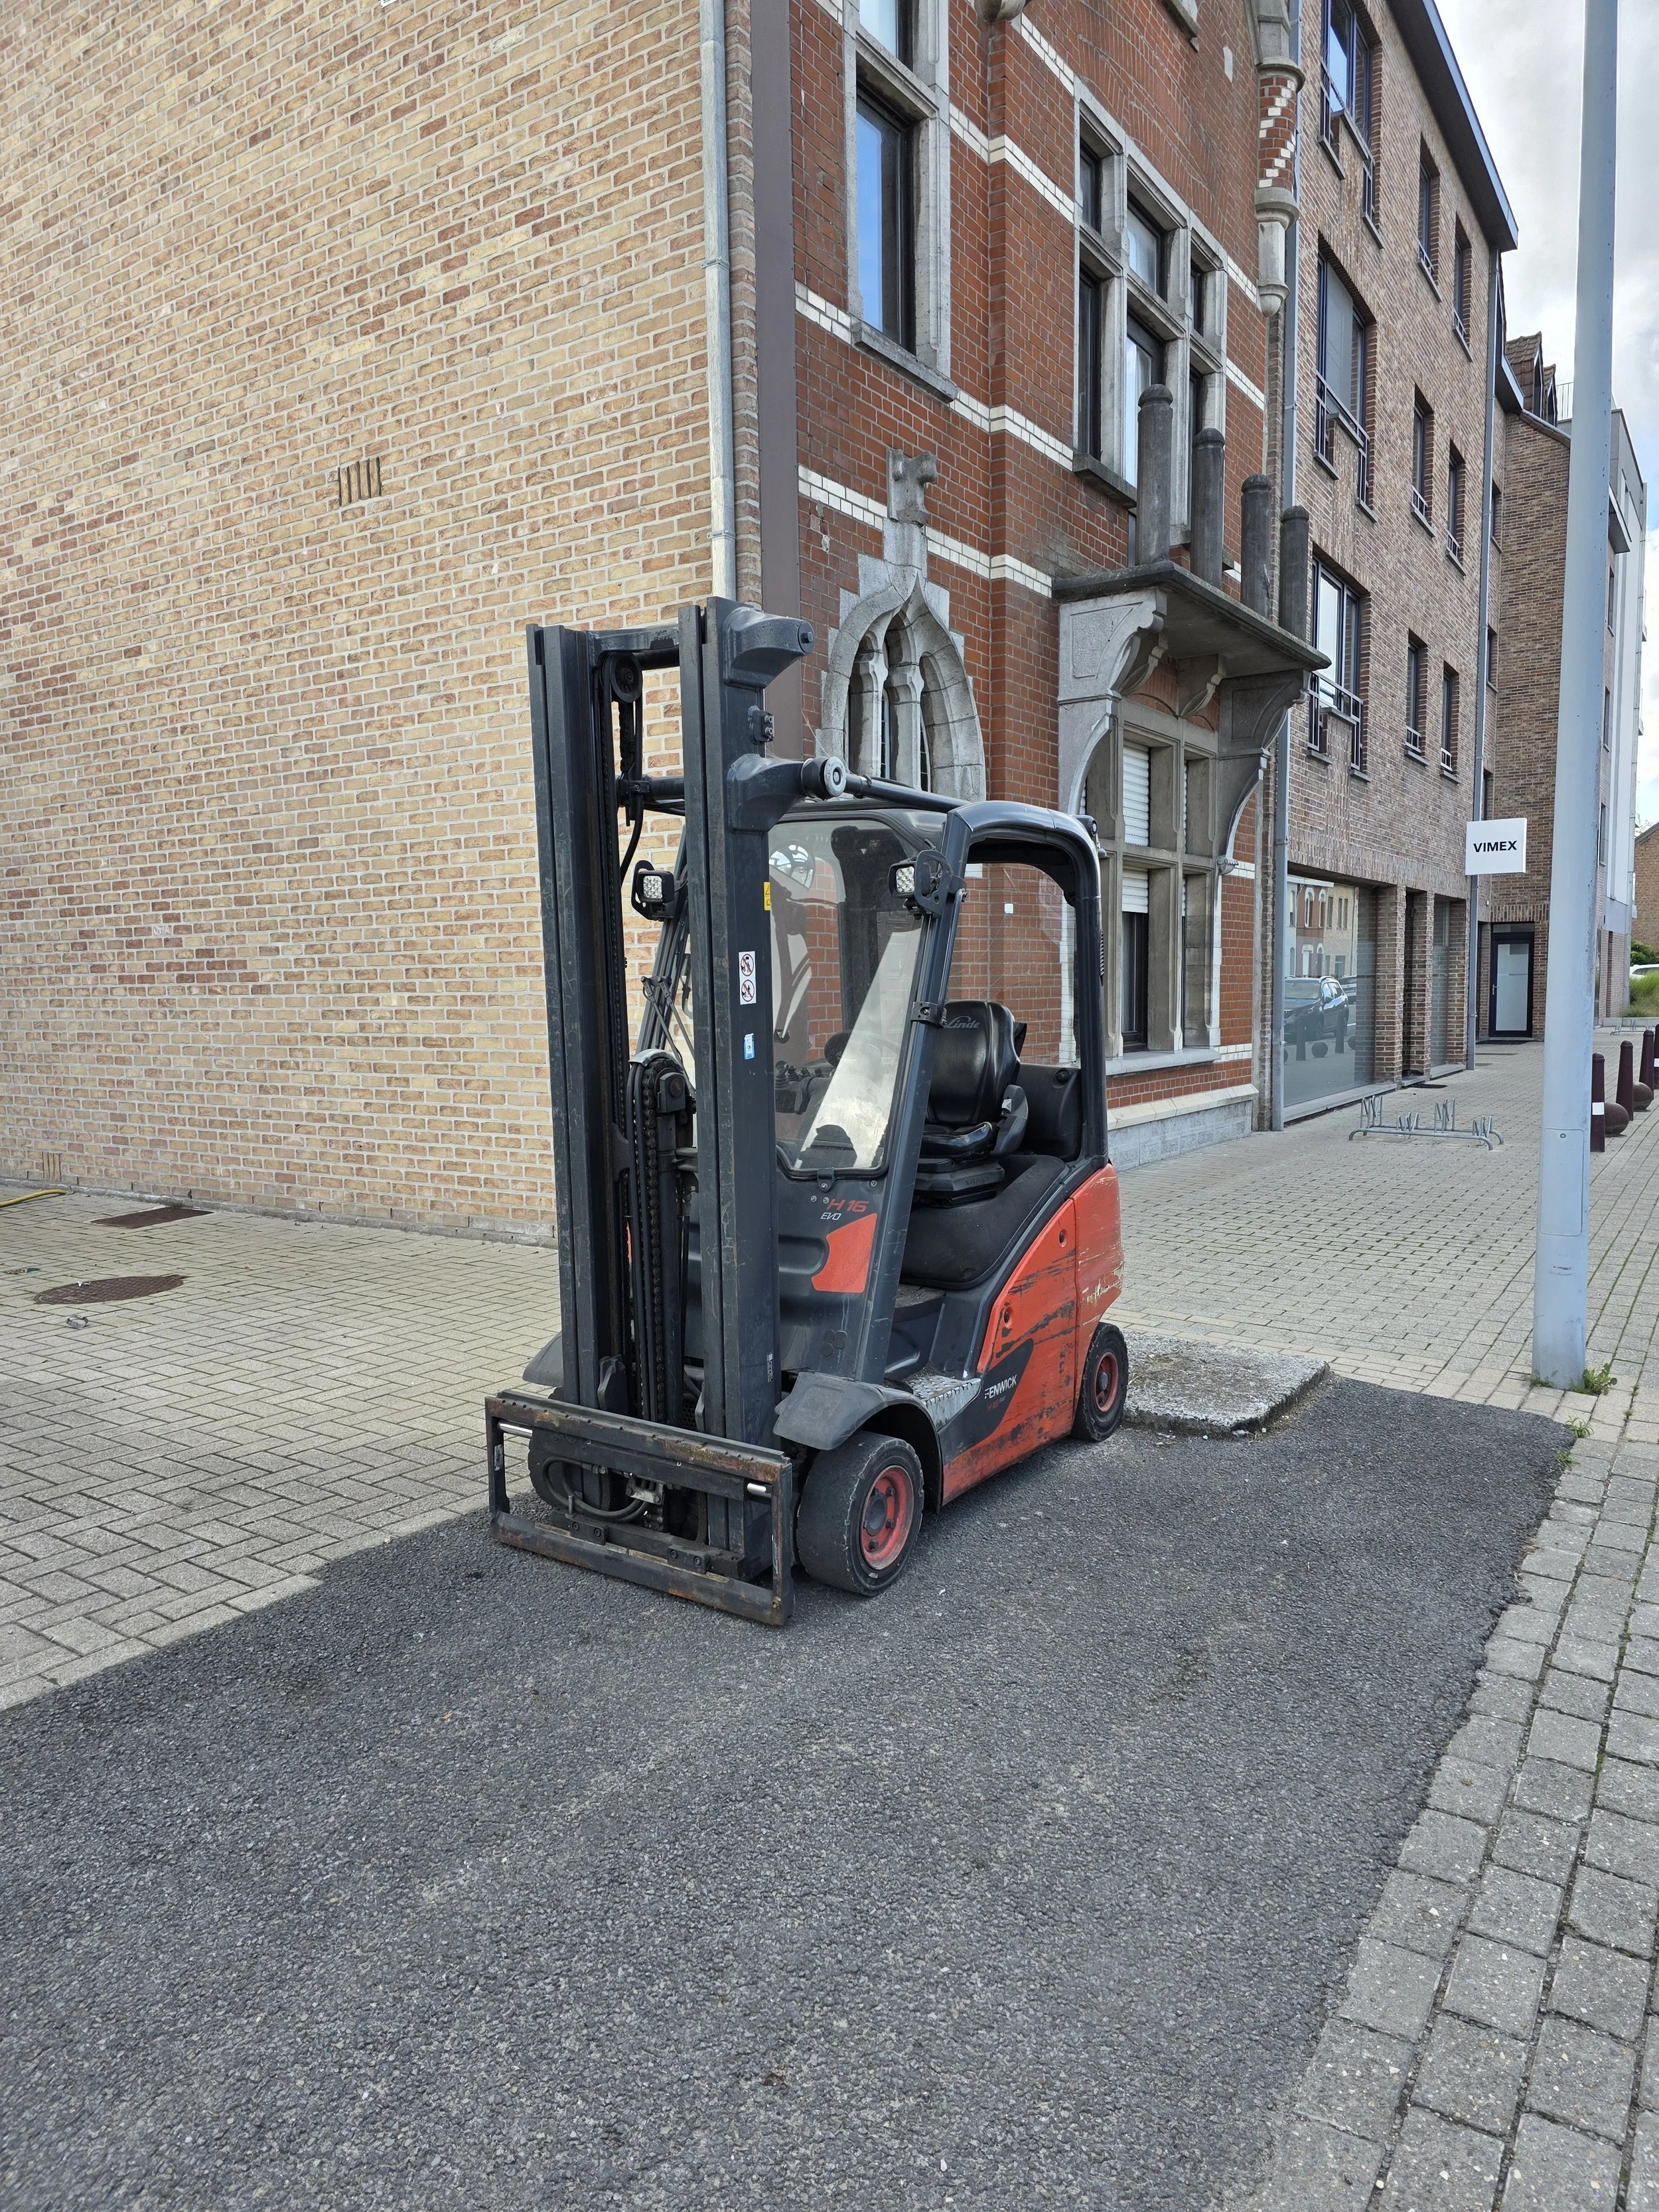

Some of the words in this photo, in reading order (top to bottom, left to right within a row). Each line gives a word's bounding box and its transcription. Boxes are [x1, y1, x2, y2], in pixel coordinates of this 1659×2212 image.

[1473, 840, 1517, 853] VIMEX
[944, 1015, 980, 1029] Linde
[820, 1212, 841, 1220] EVO
[984, 1374, 1017, 1399] FENWICK
